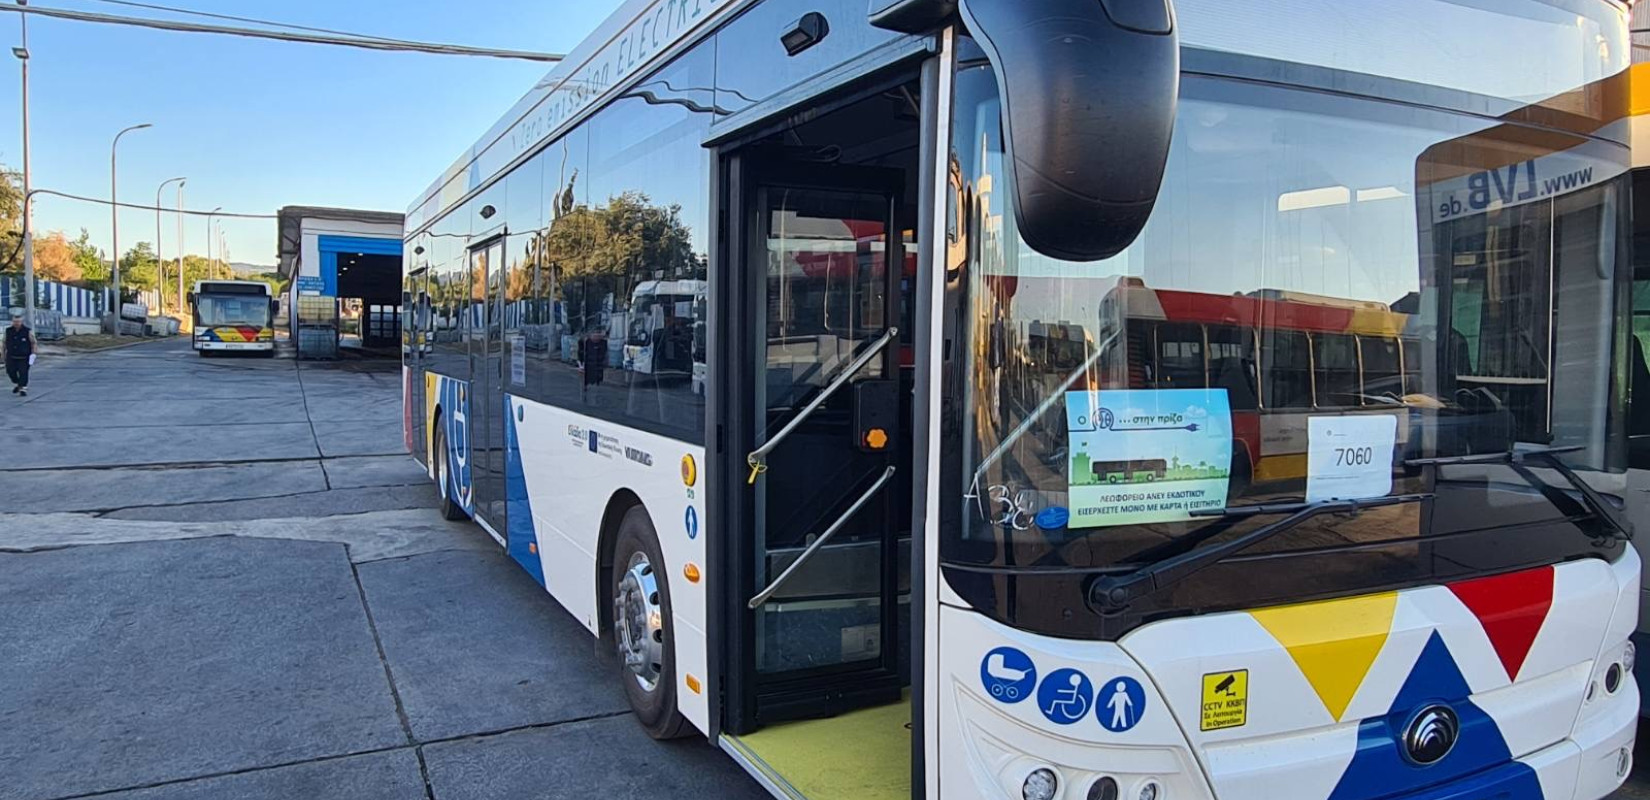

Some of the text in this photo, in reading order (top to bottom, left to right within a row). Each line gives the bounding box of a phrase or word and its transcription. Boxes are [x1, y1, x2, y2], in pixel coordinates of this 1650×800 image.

[1334, 446, 1372, 467] 7060
[1100, 493, 1145, 502] ΛΕΩΦΟΡΕΙΟ
[1166, 490, 1205, 499] ΕΚΔΟΤΙΚΟΥ
[1078, 505, 1118, 515] ΕΙΣΕΡΧΕΣΤΕ
[1120, 504, 1145, 513] ΜΟΝΟ
[1147, 503, 1159, 512] ΜΕ
[1159, 502, 1182, 511] ΚΑΡΤΑ
[1189, 499, 1222, 509] ΕΙΣΙΤΗΡΙΟ
[1204, 701, 1223, 711] CCTV
